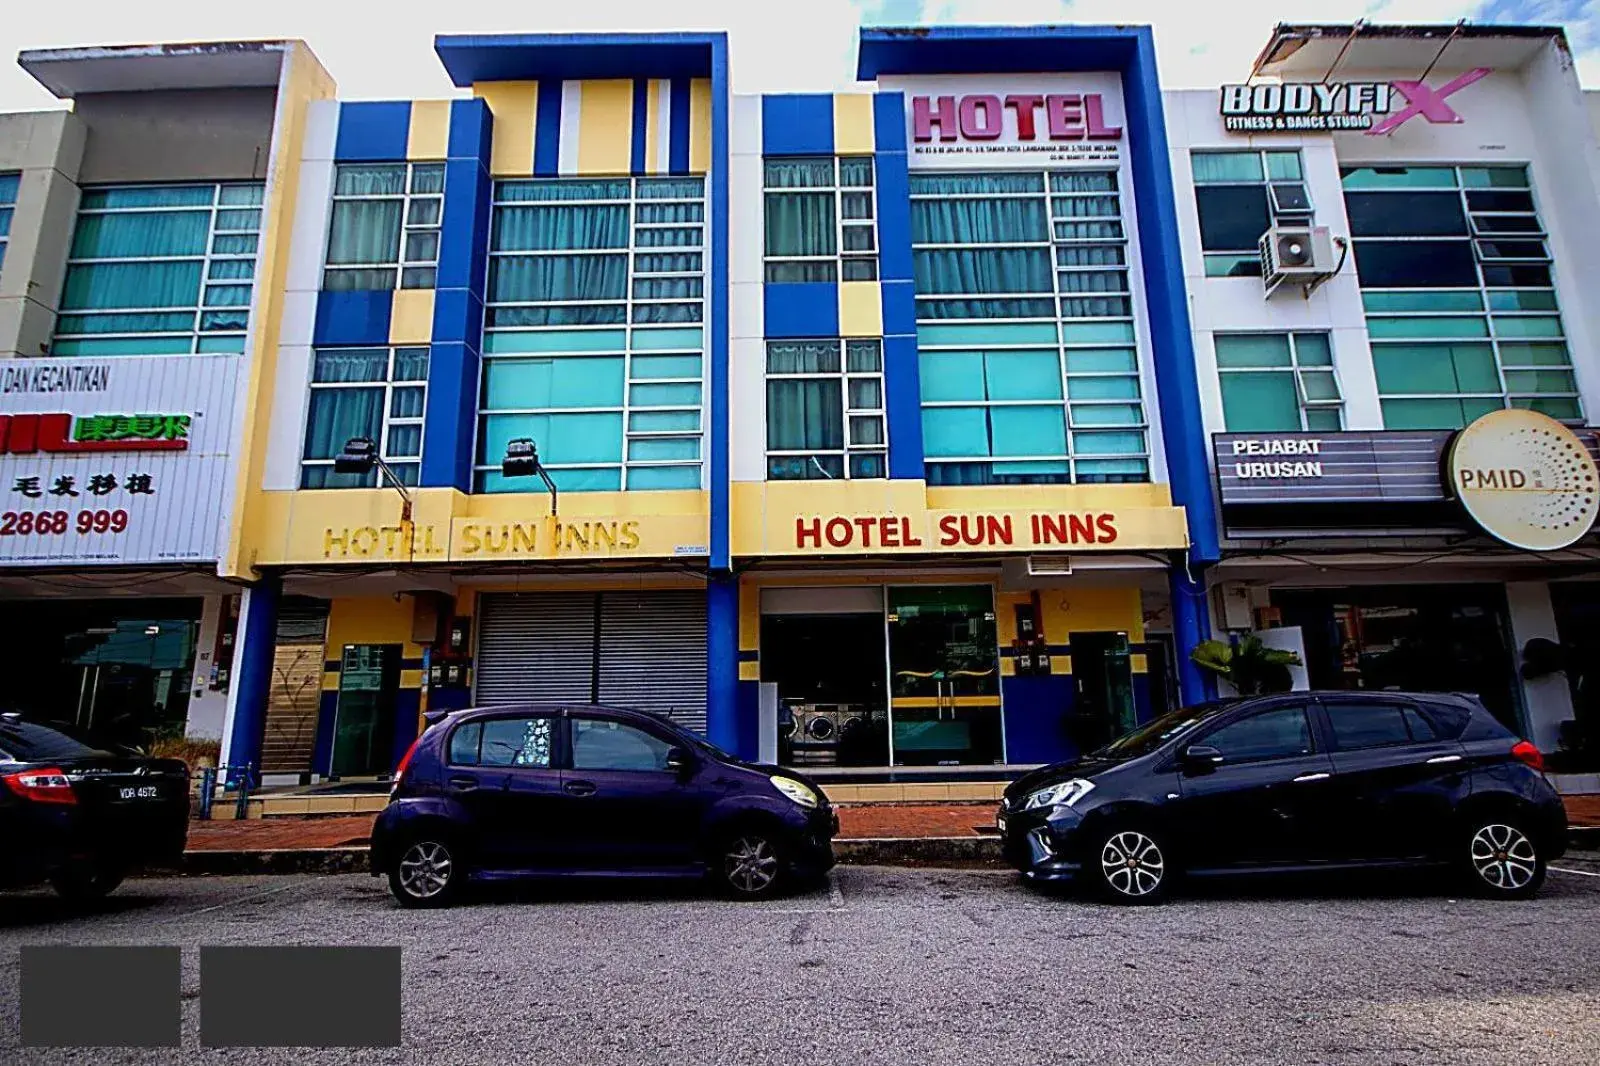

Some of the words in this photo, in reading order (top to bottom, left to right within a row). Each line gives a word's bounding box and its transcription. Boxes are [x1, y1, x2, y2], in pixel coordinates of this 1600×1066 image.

[1220, 67, 1494, 136] BODYFIX
[912, 94, 1123, 142] HOTEL
[1226, 116, 1273, 130] FITNESS
[1275, 117, 1285, 129] &
[1286, 115, 1325, 128] DANCE
[1327, 113, 1372, 128] STUDIO
[4, 367, 30, 393] DAN
[30, 365, 110, 393] KECANTIKAN
[1232, 439, 1322, 456] PEJABAT
[1236, 461, 1322, 478] URUSAN
[1460, 468, 1526, 489] PMID
[76, 509, 128, 535] 999
[796, 516, 922, 548] HOTEL
[940, 514, 1014, 546] SUN
[1031, 513, 1118, 544] INNS
[462, 524, 537, 554] SUN
